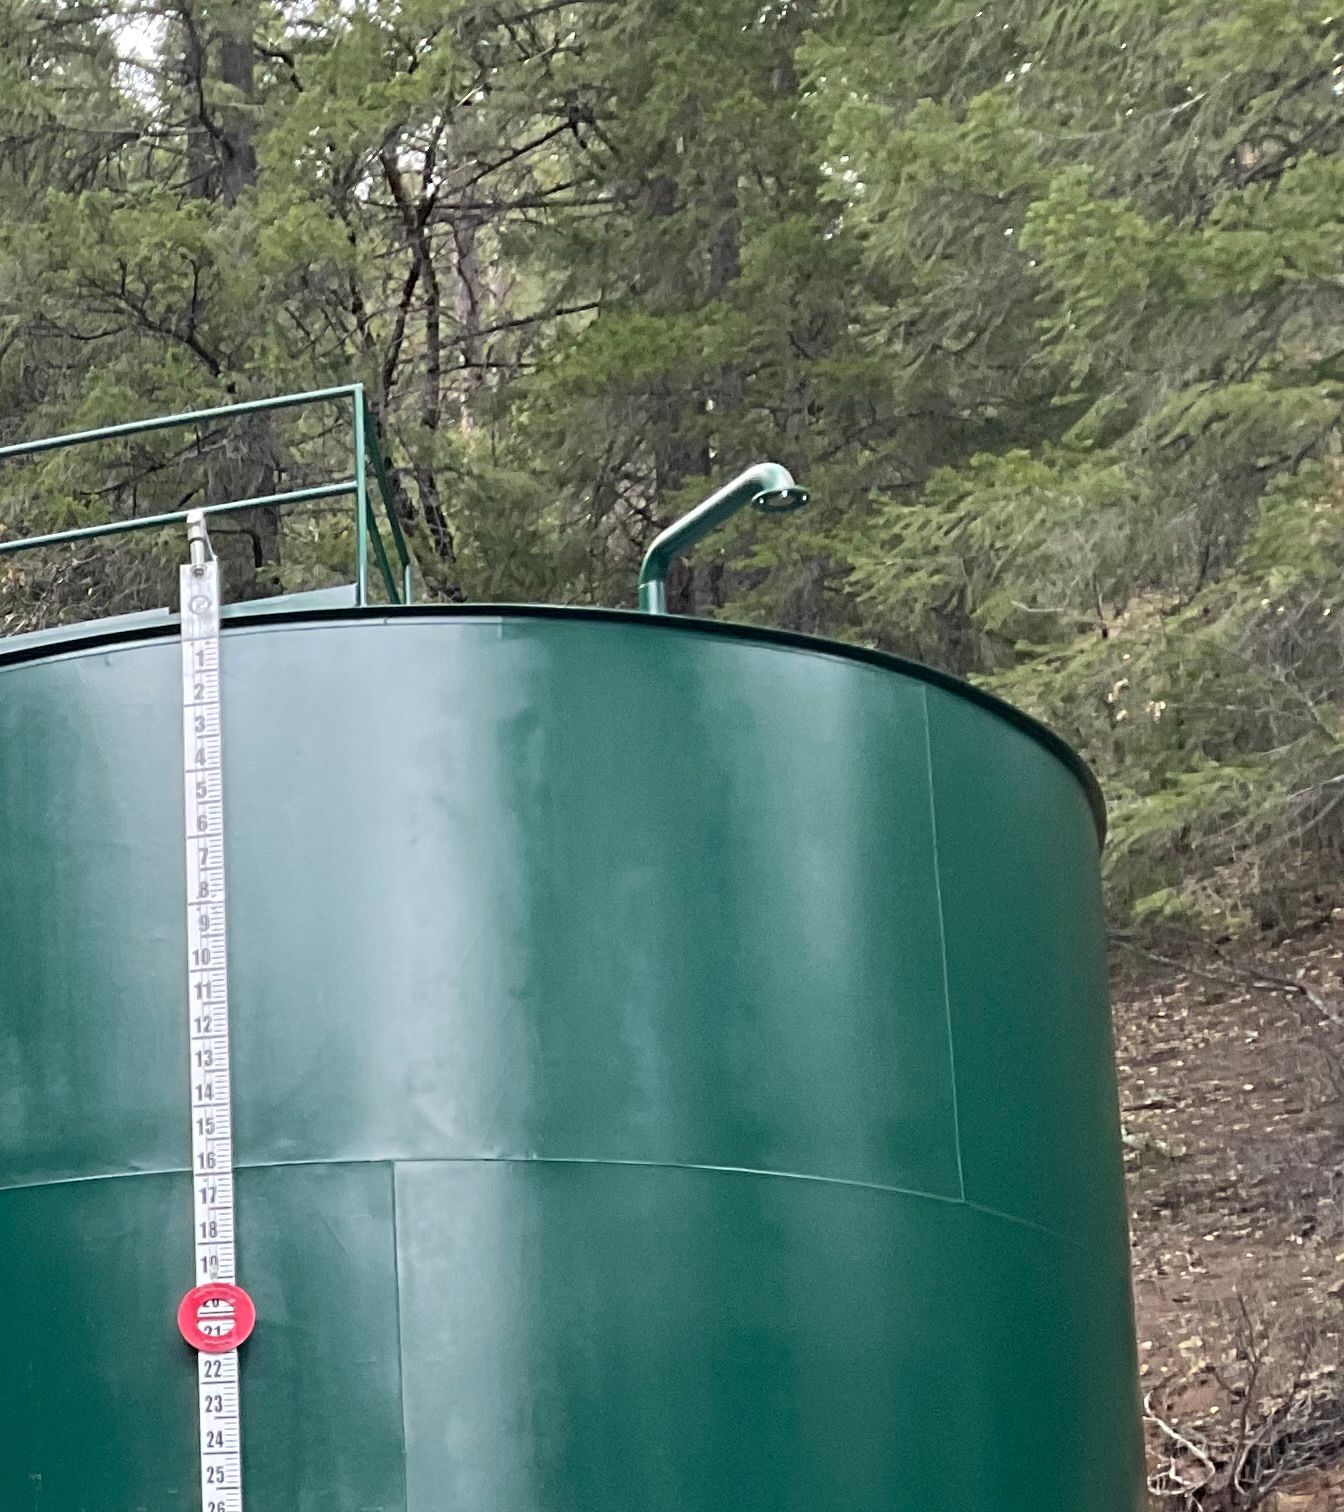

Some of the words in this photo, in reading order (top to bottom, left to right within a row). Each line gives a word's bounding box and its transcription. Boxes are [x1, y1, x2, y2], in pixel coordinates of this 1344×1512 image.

[196, 651, 204, 666] 1
[194, 684, 204, 699] 2
[195, 717, 206, 732] 3
[195, 749, 206, 765] 4
[196, 783, 207, 798] 5
[196, 815, 208, 831] 6
[198, 848, 209, 865] 7
[199, 882, 209, 898] 8
[199, 915, 210, 931] 9
[192, 949, 211, 965] 10
[193, 982, 211, 999] 11
[194, 1017, 212, 1033] 12
[195, 1051, 213, 1067] 13
[195, 1084, 213, 1100] 14
[196, 1118, 214, 1135] 15
[197, 1153, 216, 1169] 16
[199, 1187, 217, 1203] 17
[200, 1222, 218, 1238] 18
[204, 1360, 222, 1377] 22
[205, 1396, 223, 1413] 23
[206, 1431, 224, 1448] 24
[207, 1466, 225, 1484] 25
